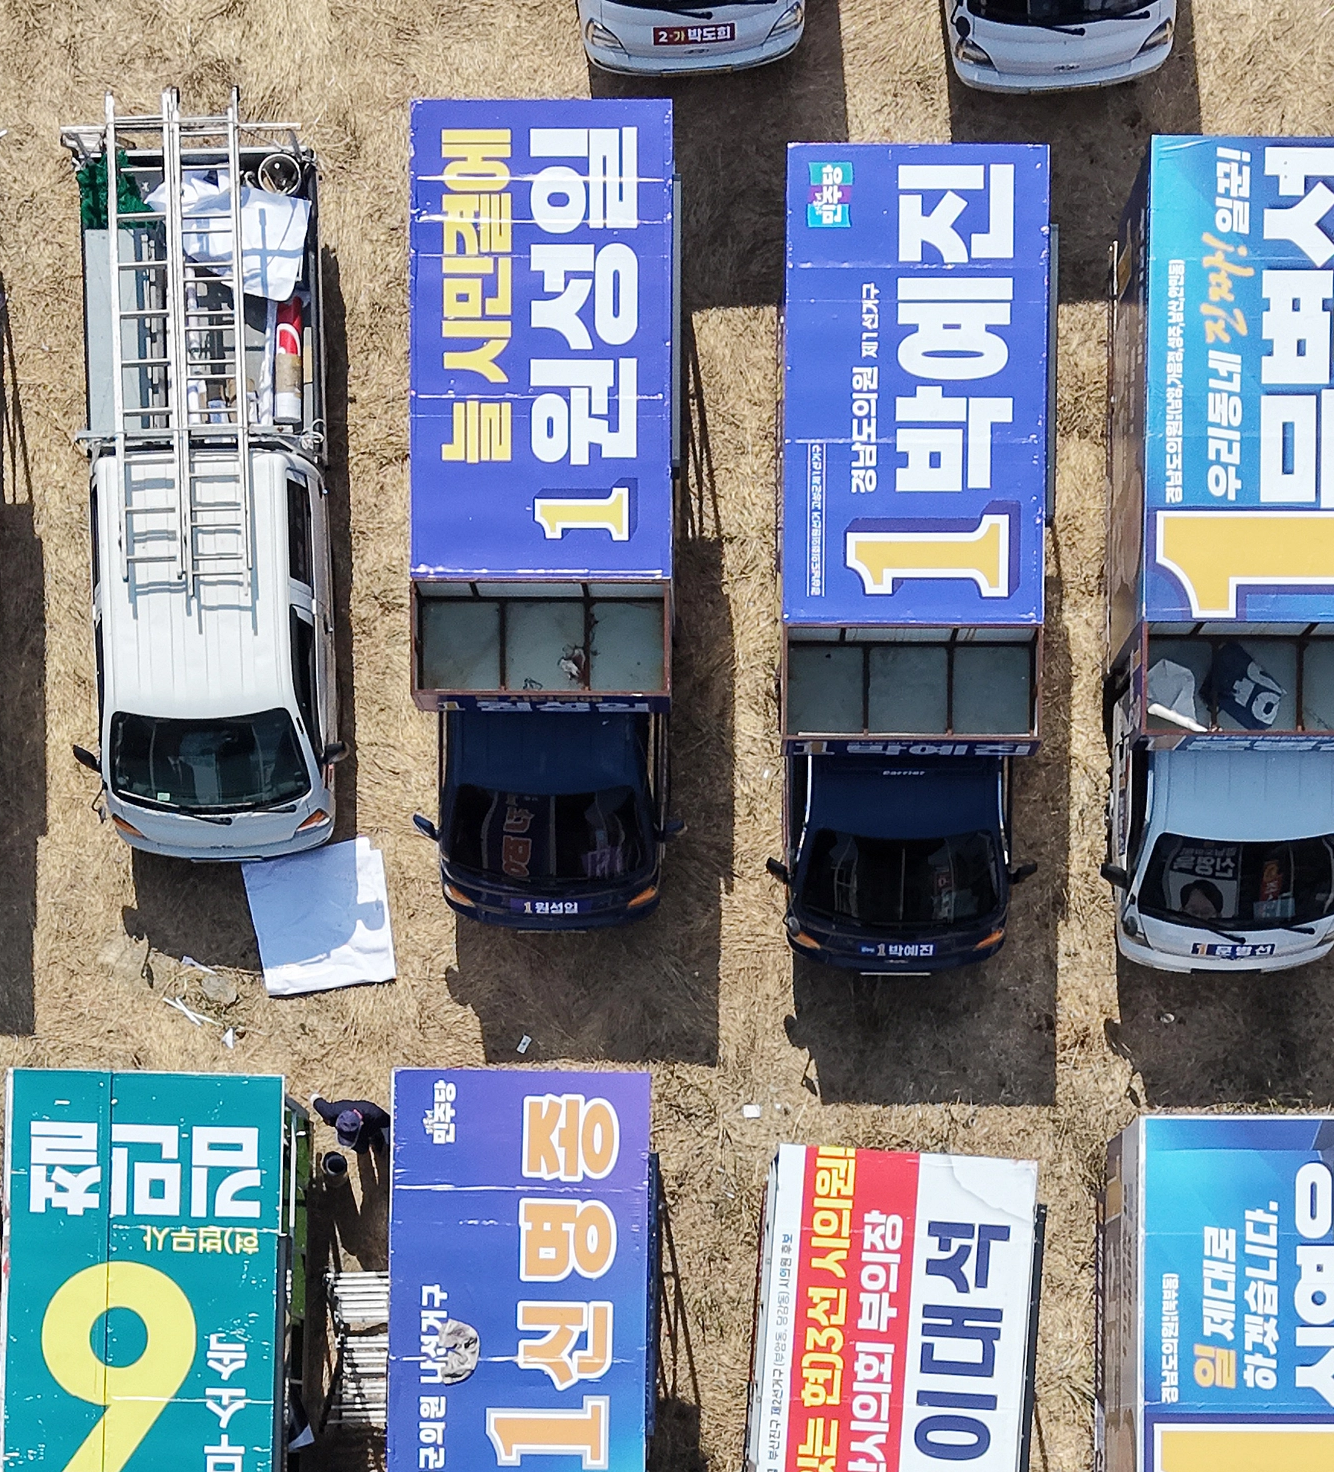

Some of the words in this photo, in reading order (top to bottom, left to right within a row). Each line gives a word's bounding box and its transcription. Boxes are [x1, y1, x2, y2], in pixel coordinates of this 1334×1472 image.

[658, 30, 685, 42] 2-가
[688, 27, 730, 41] 박도희
[823, 164, 842, 224] 민주당
[441, 129, 512, 383] 시민곁에
[530, 127, 638, 465] 원성일
[861, 283, 880, 358] 제1선거구
[895, 164, 1014, 492] 박예진
[441, 401, 512, 463] 늘
[852, 366, 879, 494] 경남도의원
[534, 487, 629, 541] 1
[846, 514, 1009, 597] 1
[432, 1080, 456, 1143] 민주당
[29, 1120, 262, 1218] 김민철
[143, 1226, 259, 1254] 현)법무사
[517, 1092, 619, 1390] 신명종
[780, 1257, 792, 1288] 시의원
[781, 1234, 794, 1254] 후보
[857, 1210, 903, 1331] 부의장
[1203, 1226, 1238, 1341] 제대로
[1246, 1200, 1280, 1389] 하겠습니다.
[914, 1220, 1010, 1460] 이대석
[1194, 1343, 1237, 1388] 일
[771, 1369, 784, 1416] 제2선거구
[486, 1396, 608, 1470] 1
[769, 1418, 782, 1460] 부산진구
